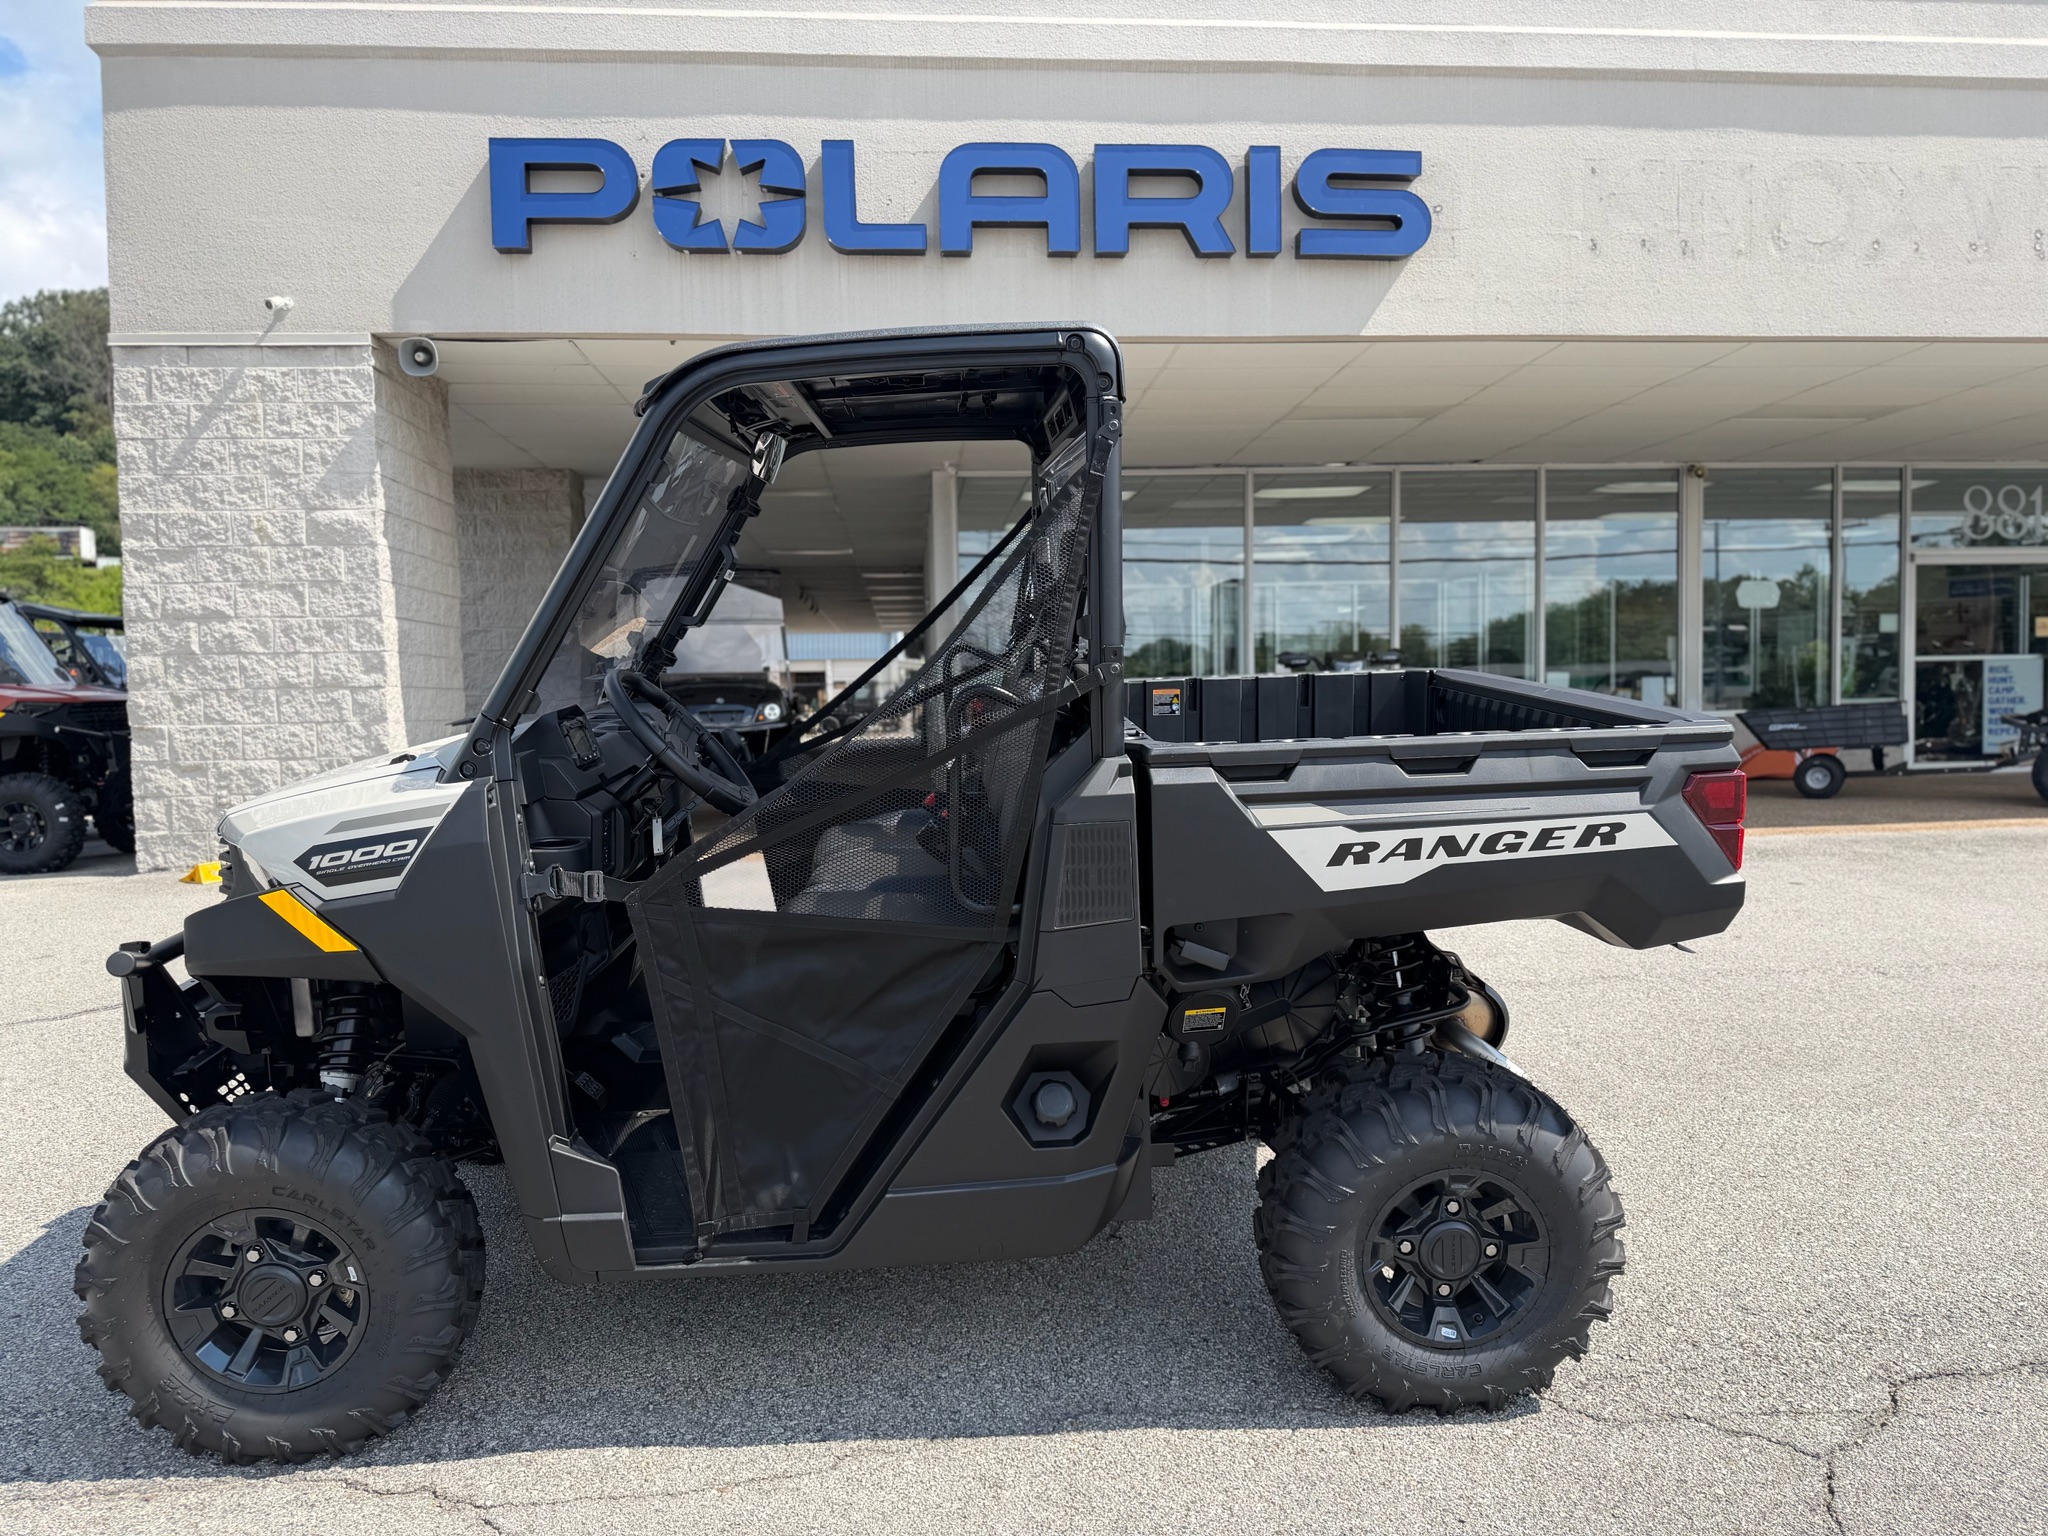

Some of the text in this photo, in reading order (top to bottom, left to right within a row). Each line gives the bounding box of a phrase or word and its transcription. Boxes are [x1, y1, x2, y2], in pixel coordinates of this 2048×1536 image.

[488, 137, 1432, 260] POLARIS
[1988, 728, 2020, 736] REPEA
[308, 839, 418, 870] 1000
[1325, 821, 1627, 868] RANGER
[315, 867, 345, 875] SINGLE
[347, 859, 391, 870] OVERHEAD
[271, 1185, 378, 1252] CARLSTAR
[1381, 1344, 1483, 1379] CARLSTAR
